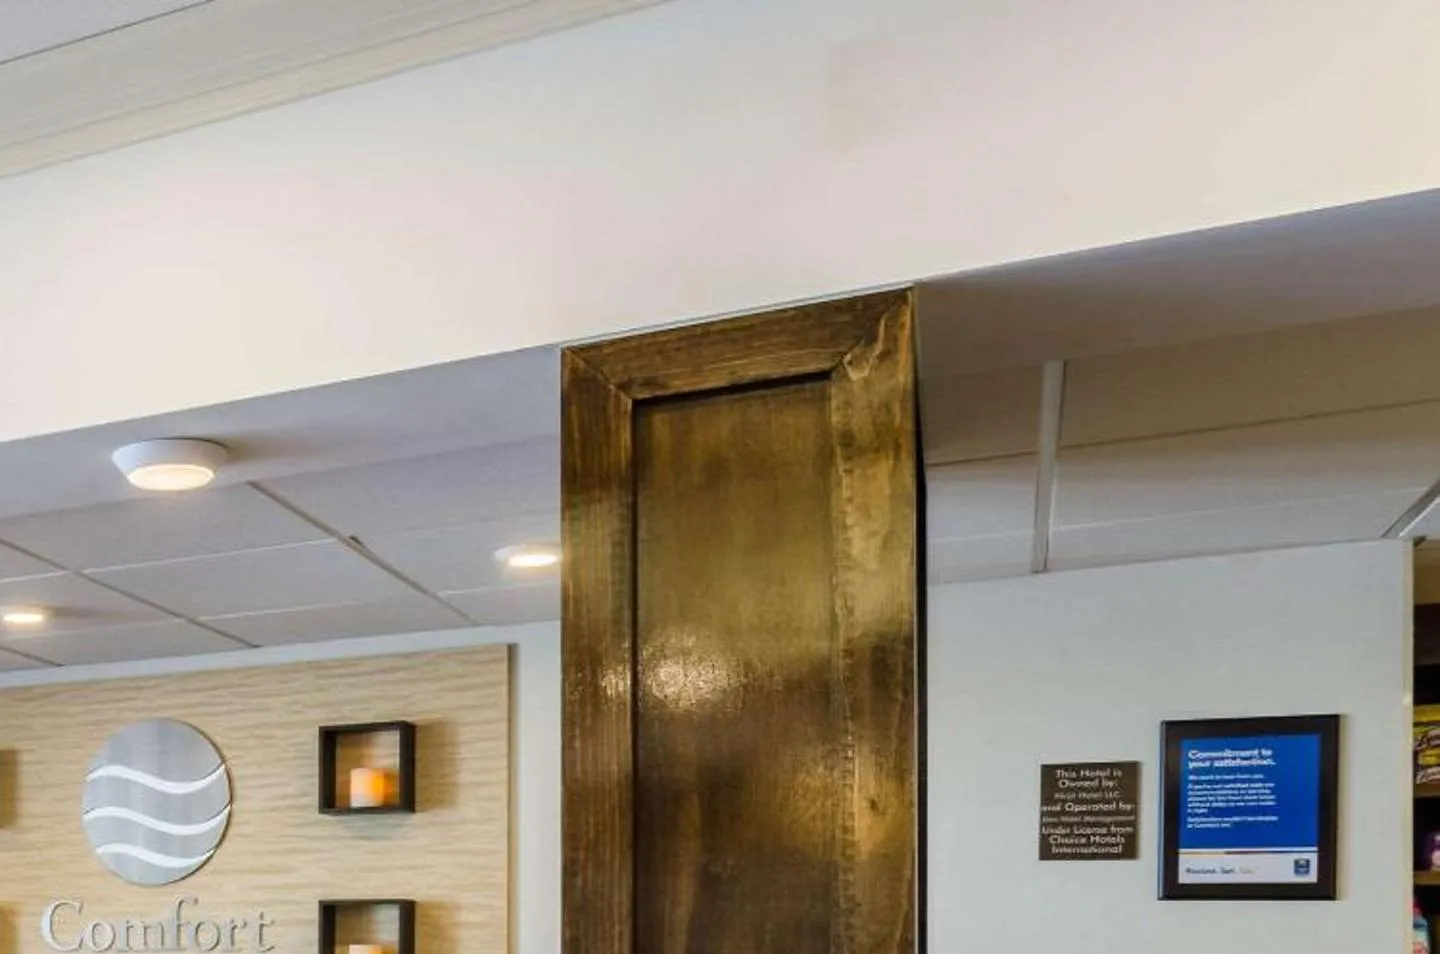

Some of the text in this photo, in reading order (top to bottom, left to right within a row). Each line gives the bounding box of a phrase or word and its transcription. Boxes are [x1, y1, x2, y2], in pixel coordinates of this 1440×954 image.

[1056, 769, 1077, 778] This
[1080, 768, 1111, 777] Hotel
[1058, 779, 1099, 788] Owned
[1064, 802, 1117, 812] Operated
[1042, 826, 1071, 835] Under
[1049, 834, 1125, 844] Choice Hotels
[1051, 844, 1123, 854] International
[41, 895, 276, 953] Comfort
